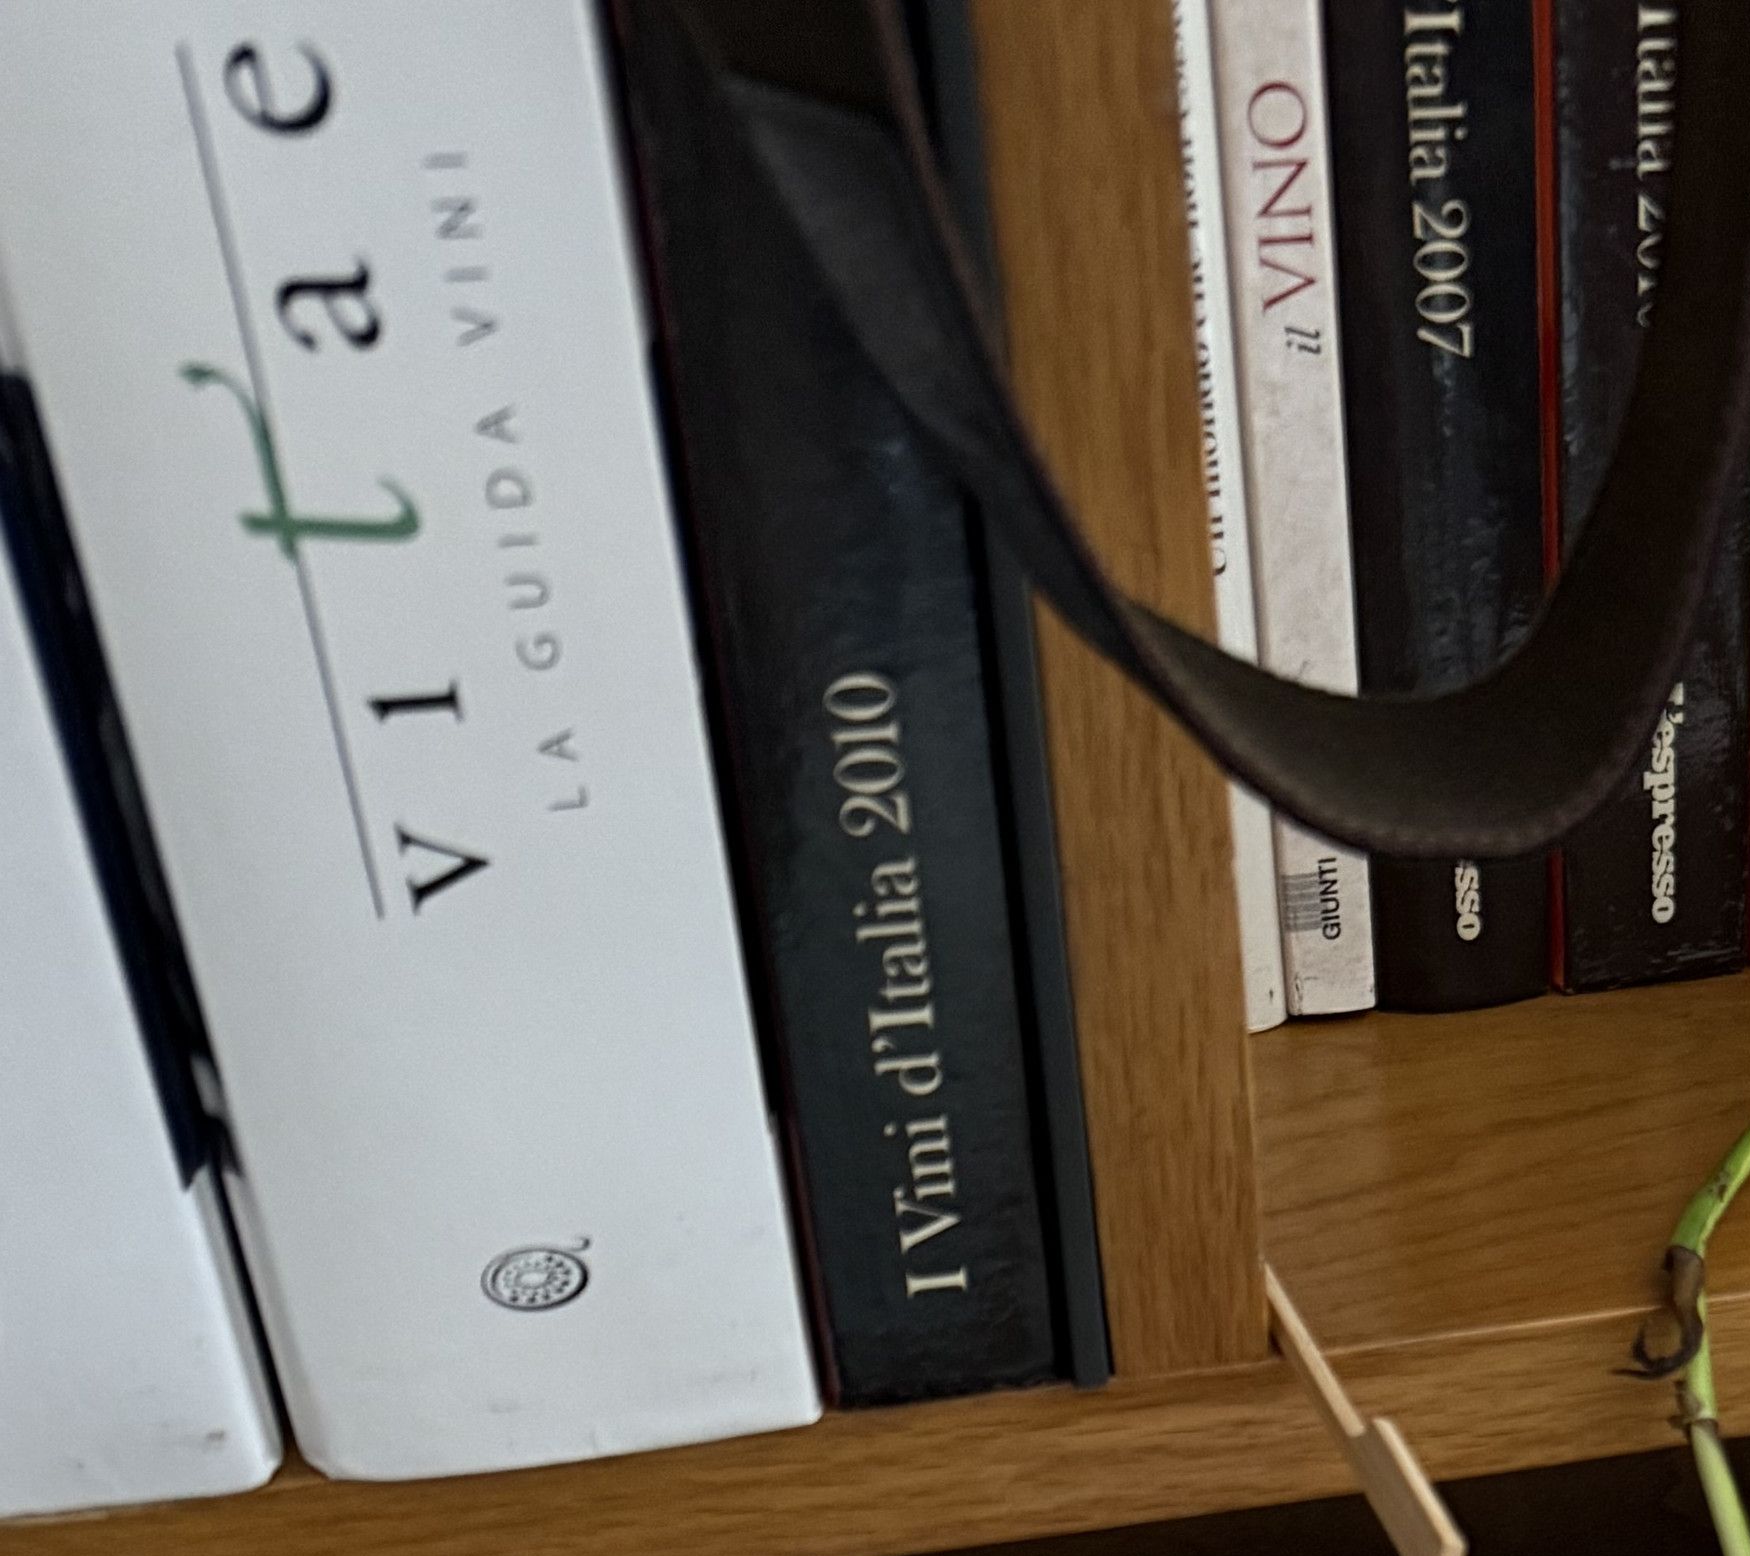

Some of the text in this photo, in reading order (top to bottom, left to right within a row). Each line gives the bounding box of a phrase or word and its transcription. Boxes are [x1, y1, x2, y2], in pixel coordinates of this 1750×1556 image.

[1236, 77, 1326, 358] il VINO
[1409, 199, 1472, 360] 2007
[418, 145, 592, 815] LA GUIDA VINI
[819, 669, 969, 1297] I Vini d'Italia 2010
[1313, 856, 1345, 940] GIUNTI
